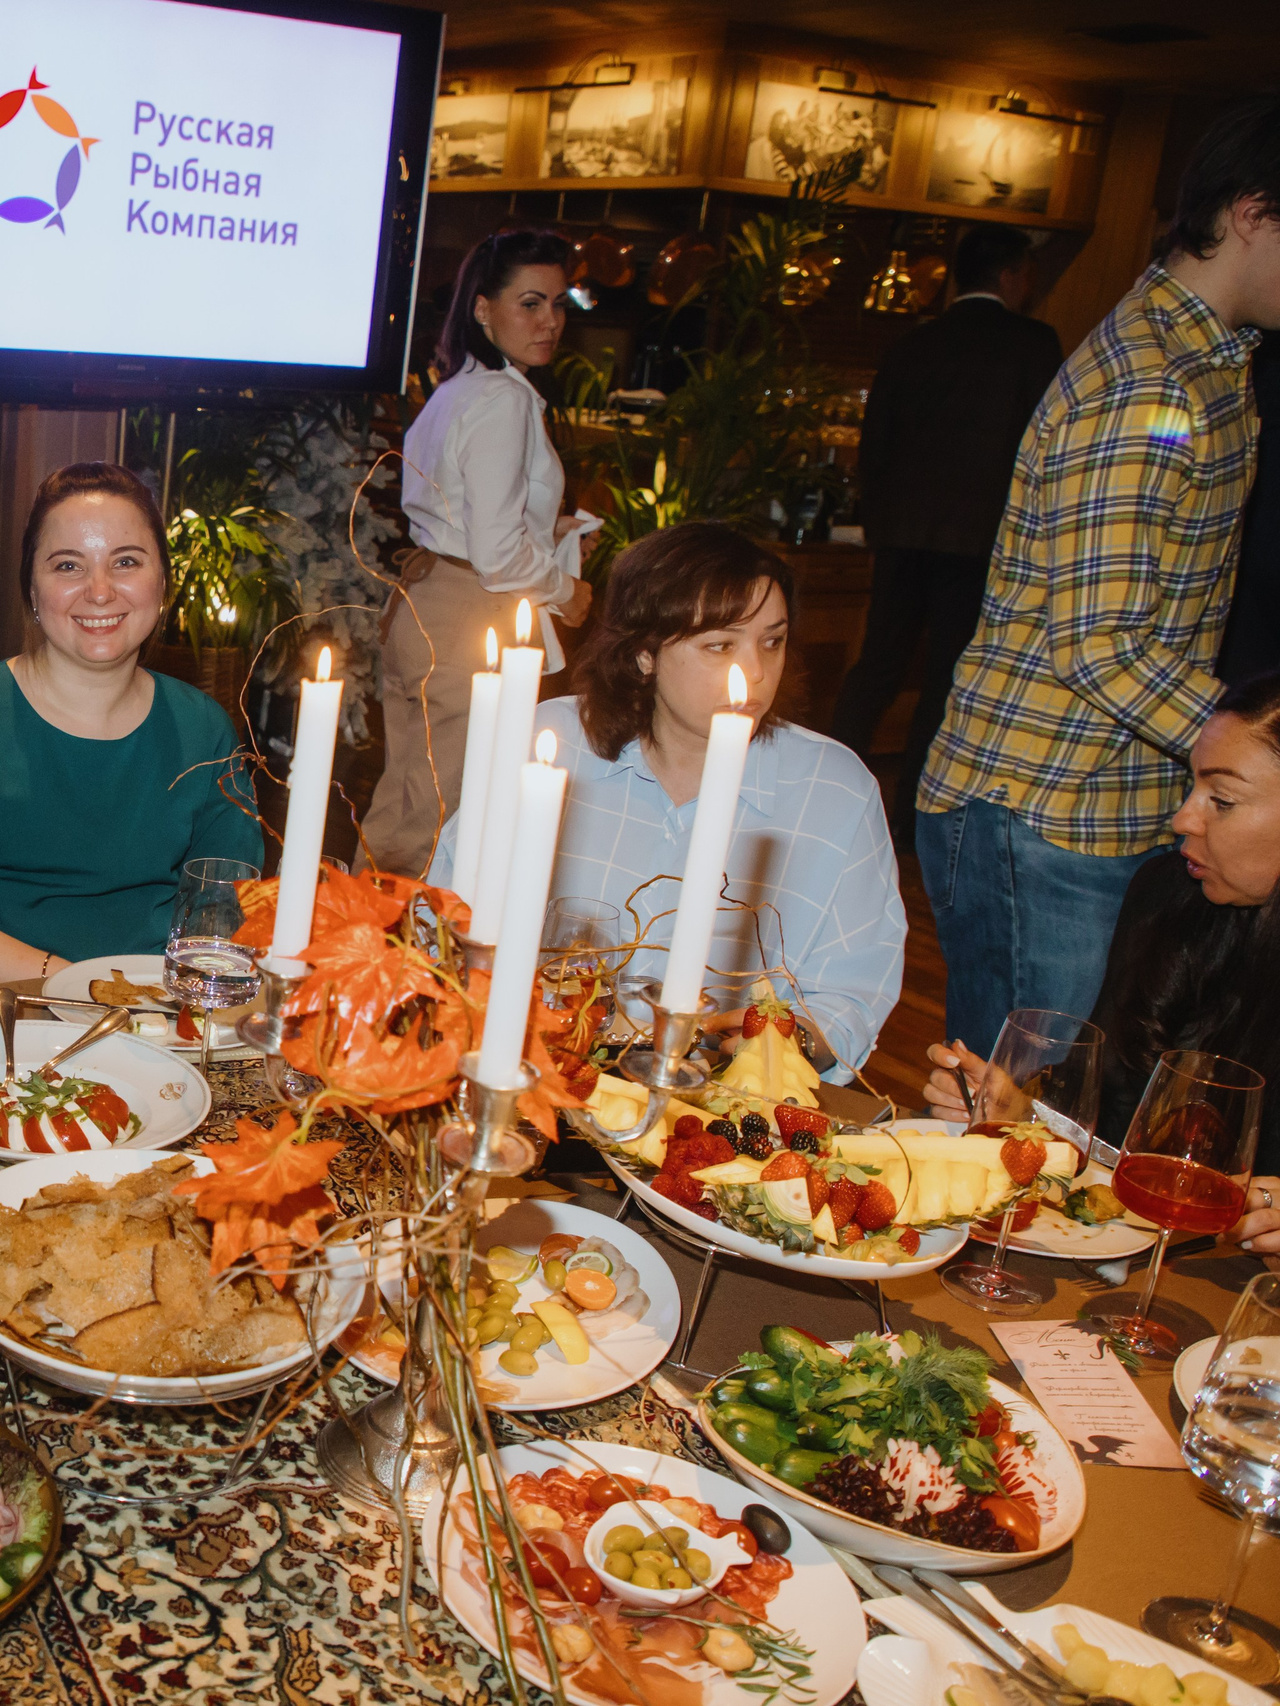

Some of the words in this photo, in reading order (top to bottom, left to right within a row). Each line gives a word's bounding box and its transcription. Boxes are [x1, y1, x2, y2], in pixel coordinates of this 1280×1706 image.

[133, 101, 274, 150] Русская
[129, 152, 261, 198] Рыбная
[126, 199, 298, 246] Компания
